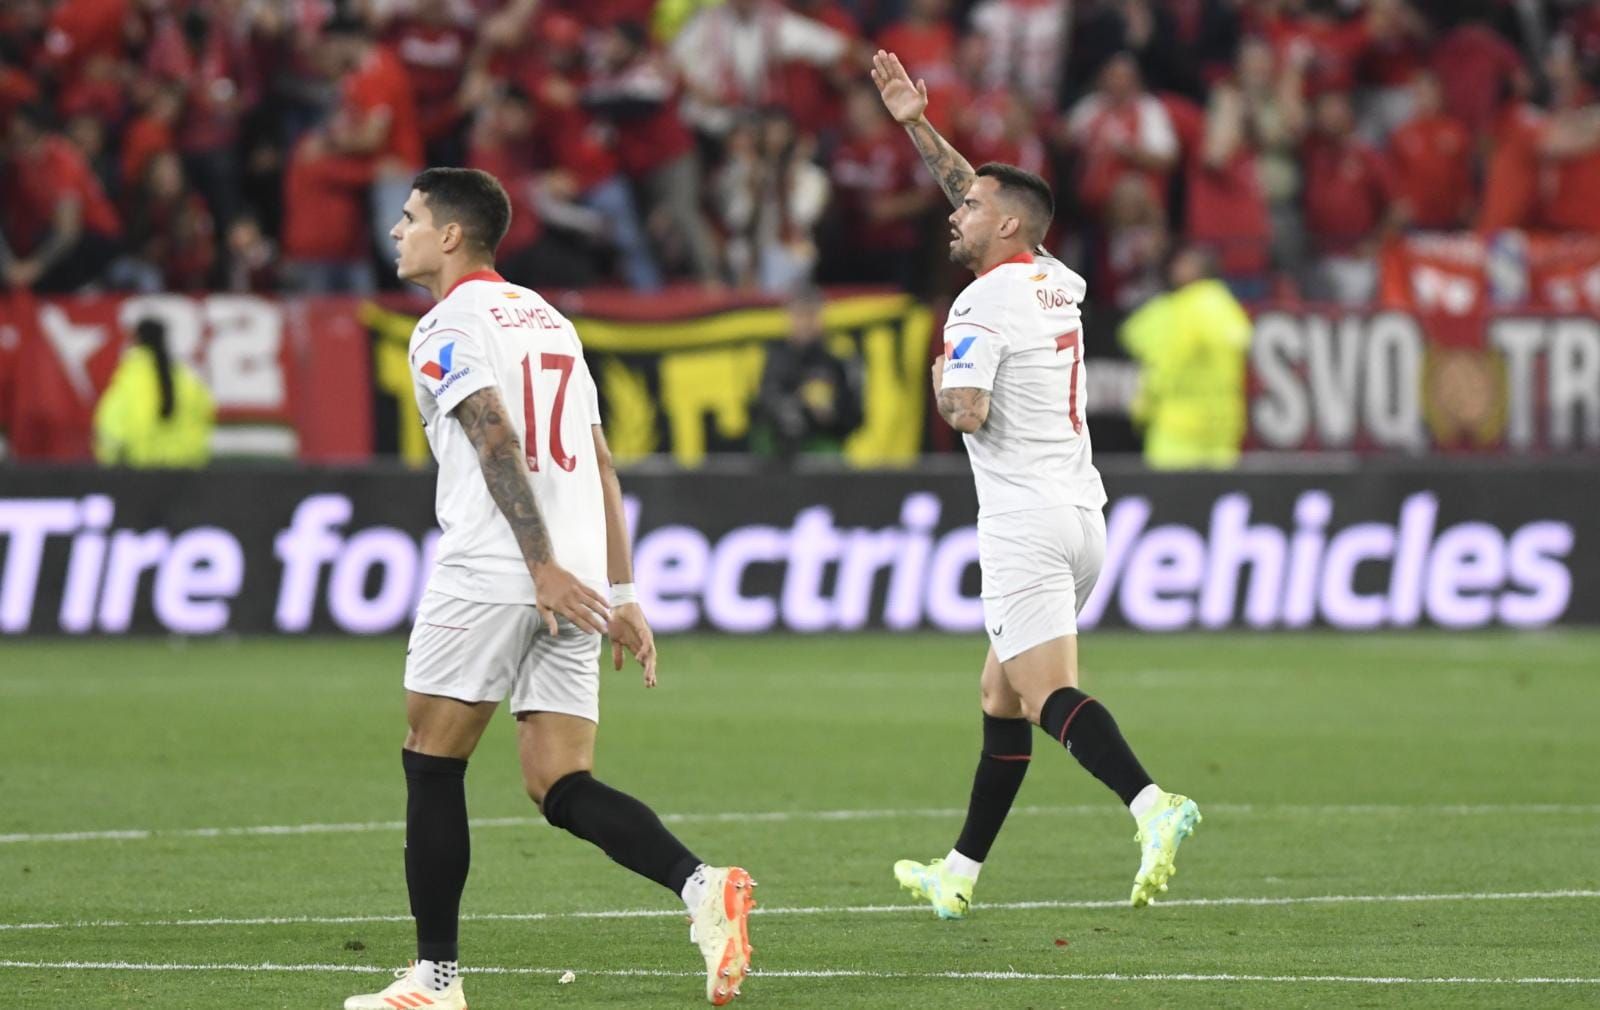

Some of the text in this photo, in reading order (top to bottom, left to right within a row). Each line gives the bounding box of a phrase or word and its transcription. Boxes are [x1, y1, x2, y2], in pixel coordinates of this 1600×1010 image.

[521, 352, 577, 473] 17
[1054, 328, 1083, 436] 7
[0, 493, 244, 633] Tire
[623, 493, 982, 632] ectric
